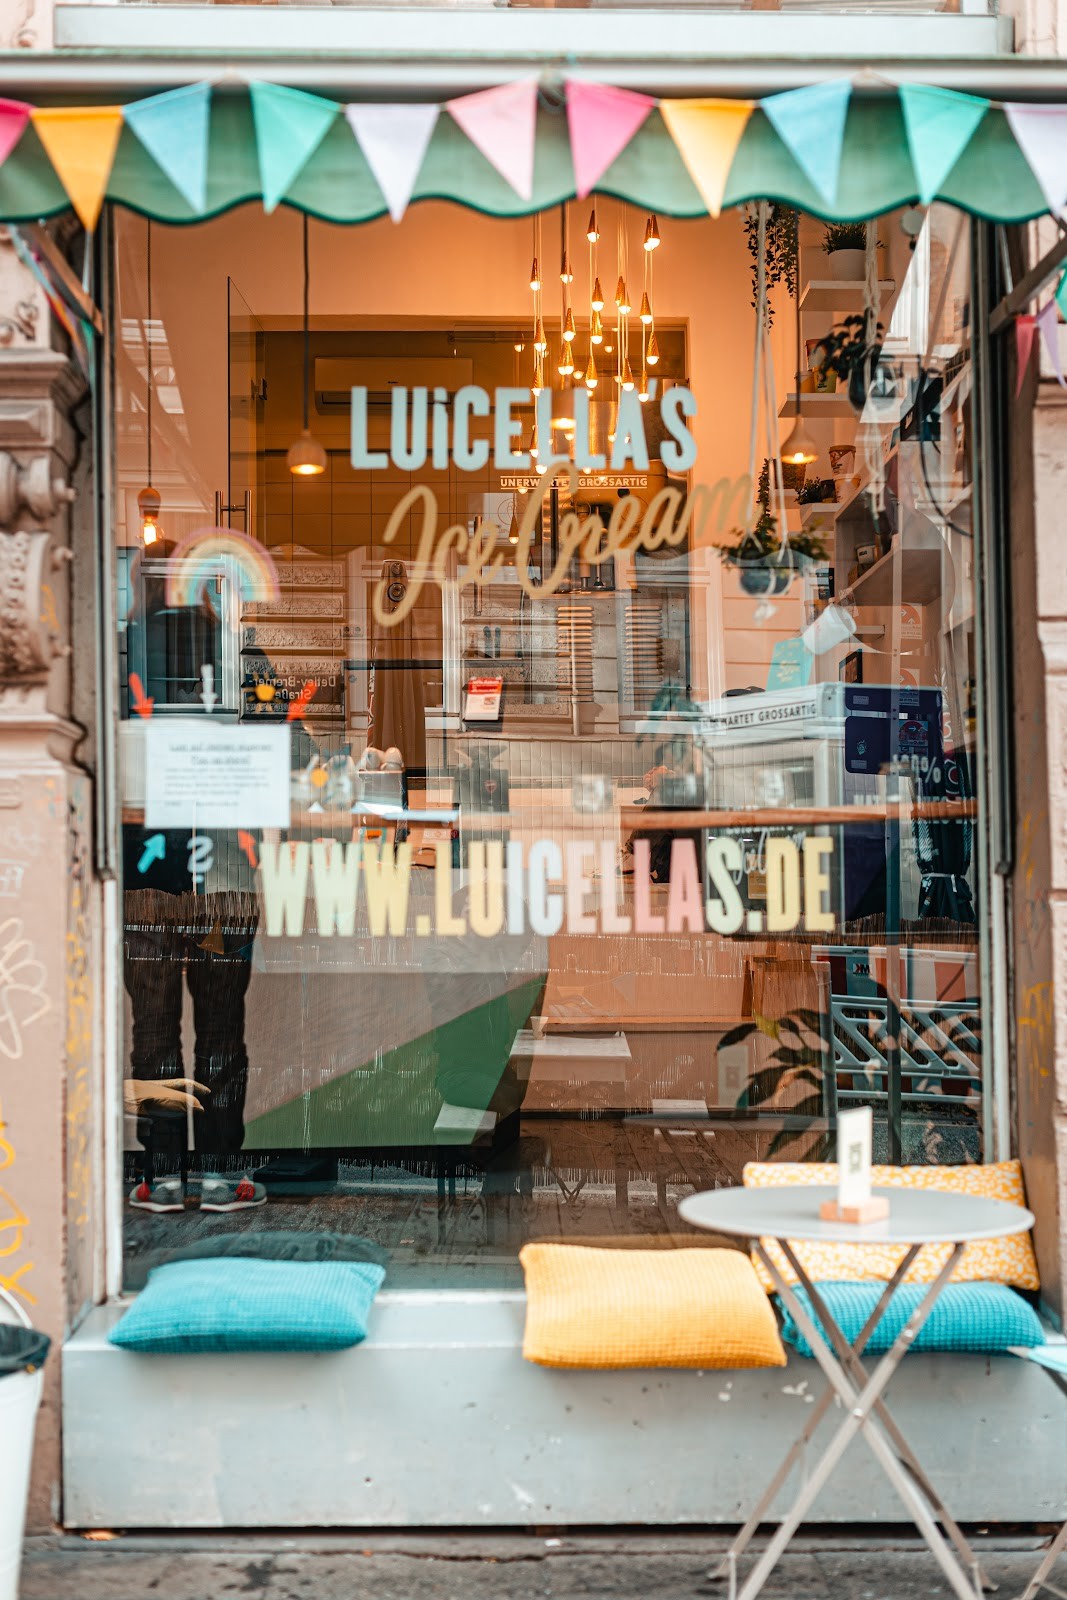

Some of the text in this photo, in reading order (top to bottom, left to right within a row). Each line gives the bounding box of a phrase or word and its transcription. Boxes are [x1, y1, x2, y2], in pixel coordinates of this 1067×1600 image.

[500, 477, 648, 488] UNERWRTE GROSSARTIG
[372, 461, 765, 628] Ice Cream
[758, 704, 817, 722] GROSSARTIG
[259, 837, 836, 938] WWW.LUICELLAS.DE
